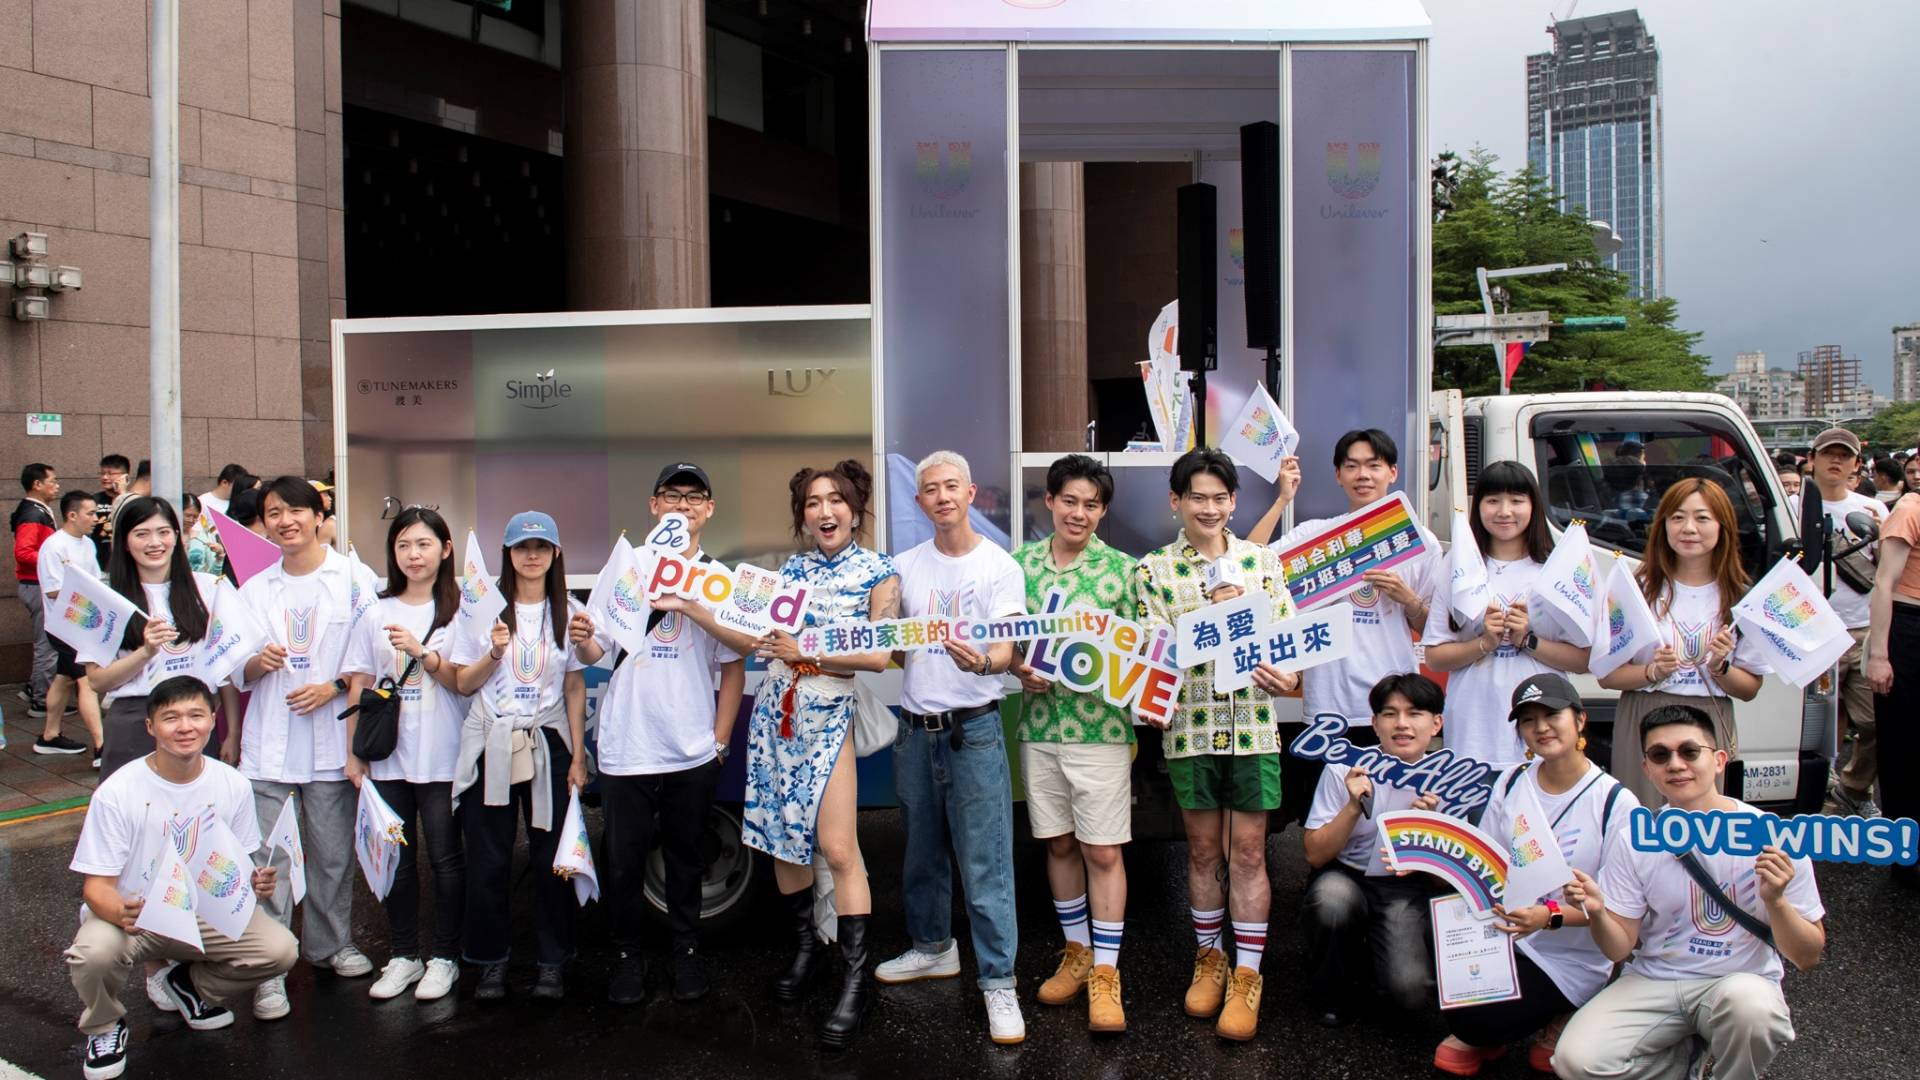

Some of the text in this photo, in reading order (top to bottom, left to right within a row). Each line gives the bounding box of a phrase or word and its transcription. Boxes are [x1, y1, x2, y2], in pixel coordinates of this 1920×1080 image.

[373, 379, 458, 391] TUNEMAKERS
[505, 379, 573, 403] Simple
[767, 367, 846, 398] LUX
[651, 518, 684, 548] Be
[1289, 527, 1366, 575] 聯合利華
[1299, 532, 1412, 596] 力挺每一種愛
[719, 609, 767, 632] Unilever
[1192, 607, 1256, 651] 為愛
[1232, 622, 1332, 675] 站出來
[1030, 638, 1178, 717] LOVE
[1293, 716, 1491, 818] Be an Ally
[1399, 830, 1466, 860] STAND
[1467, 852, 1494, 881] BY
[1636, 813, 1911, 860] LOVE WINS!
